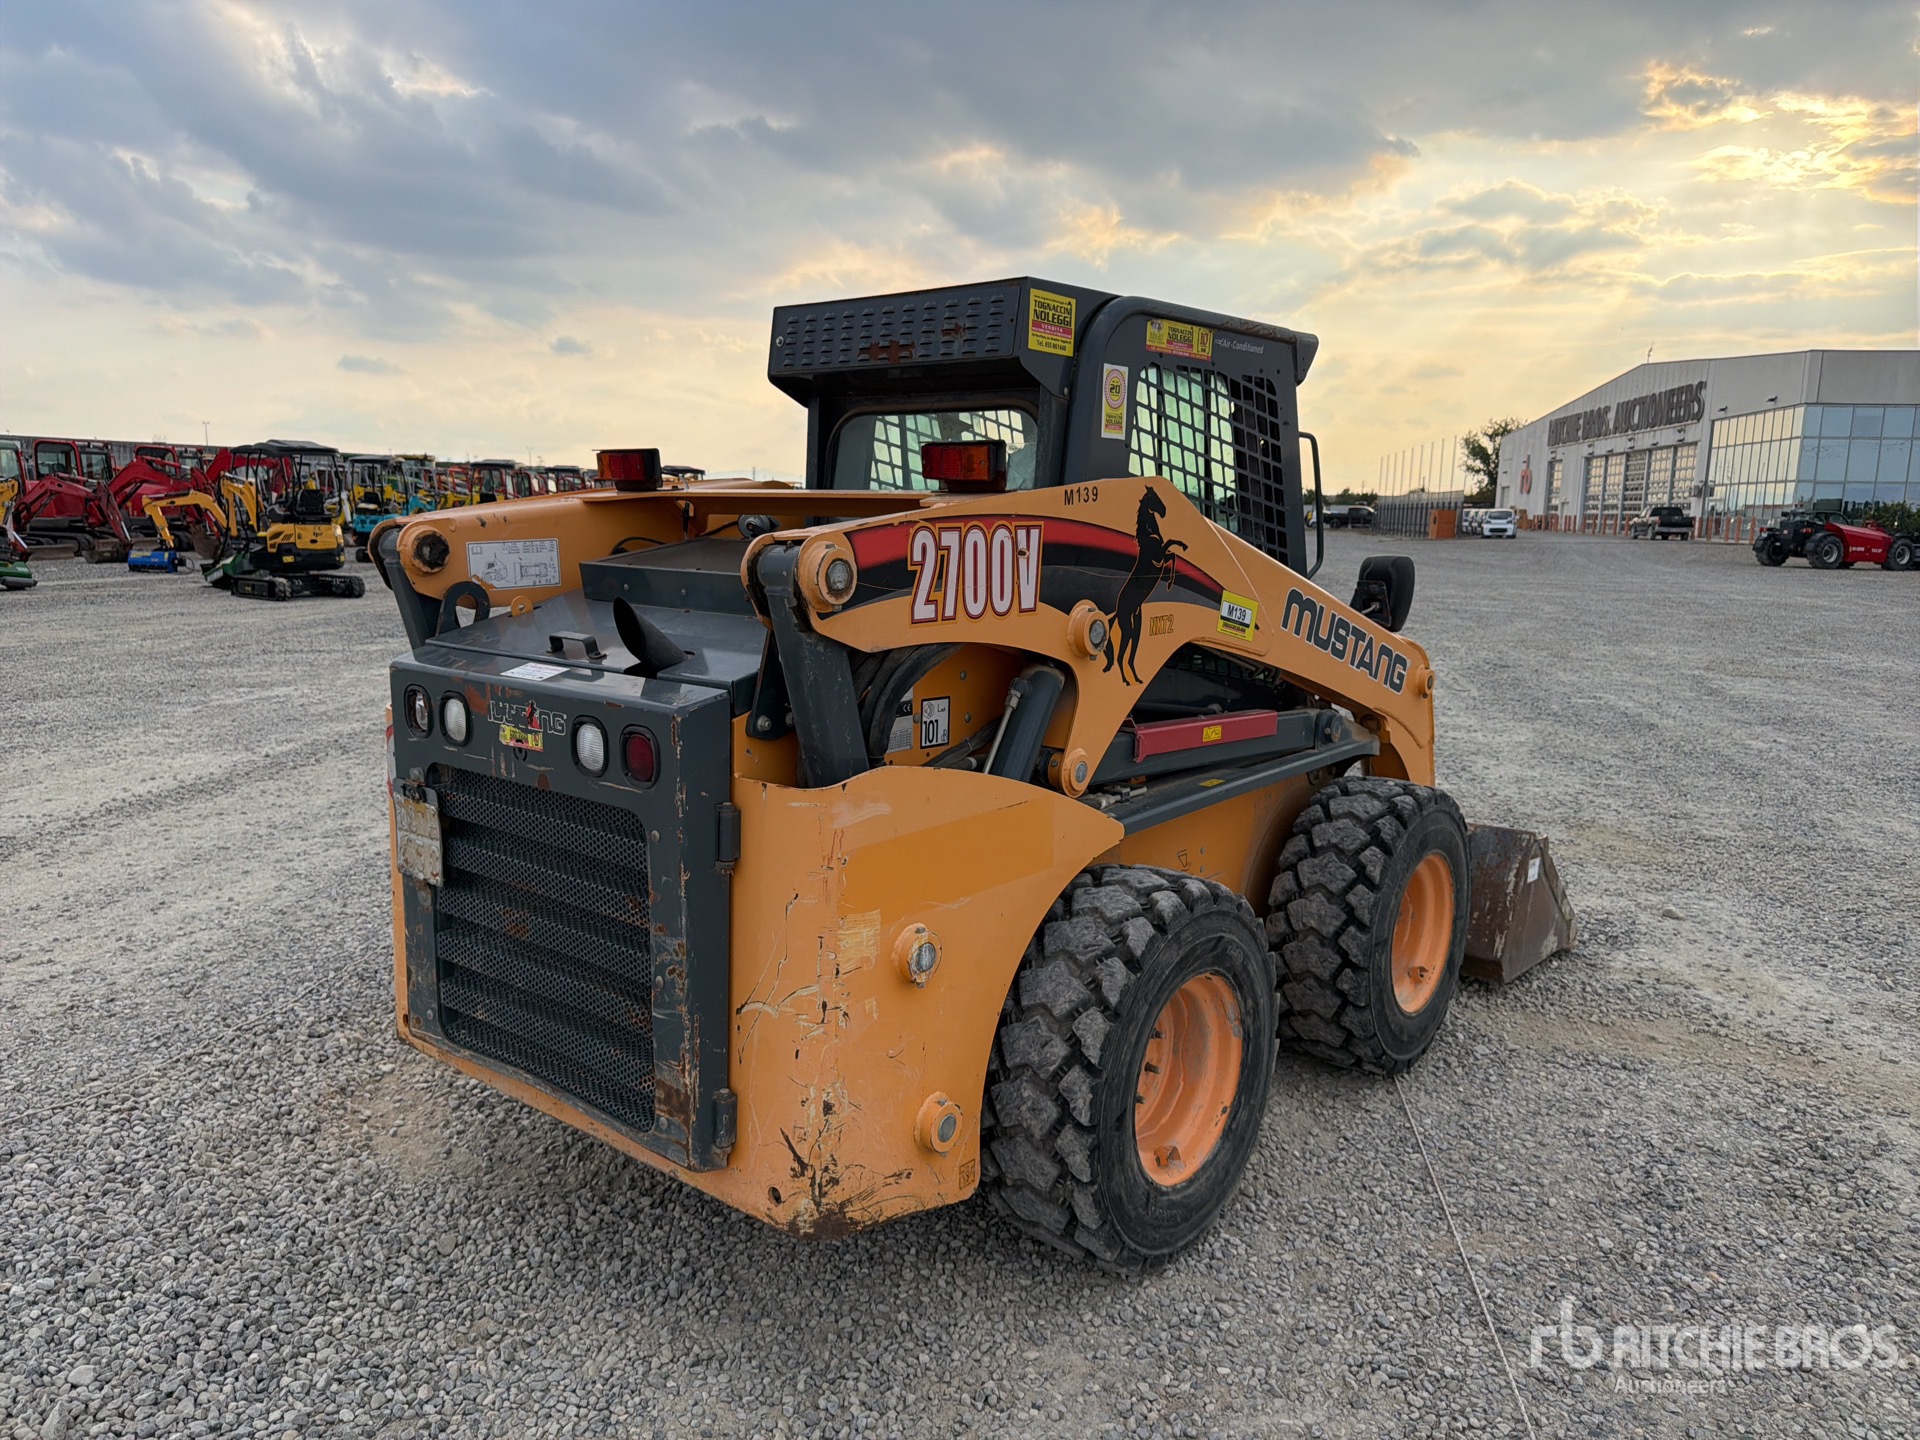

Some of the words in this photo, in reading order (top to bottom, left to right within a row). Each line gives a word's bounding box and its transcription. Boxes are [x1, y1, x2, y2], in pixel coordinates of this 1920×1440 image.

[1110, 384, 1121, 395] 20
[1612, 380, 1706, 435] AUCTIONEERS
[1064, 486, 1098, 506] M139
[910, 524, 1043, 625] 2700V
[1226, 604, 1247, 621] M139
[1280, 587, 1409, 695] MUSTANG
[923, 719, 939, 744] 101
